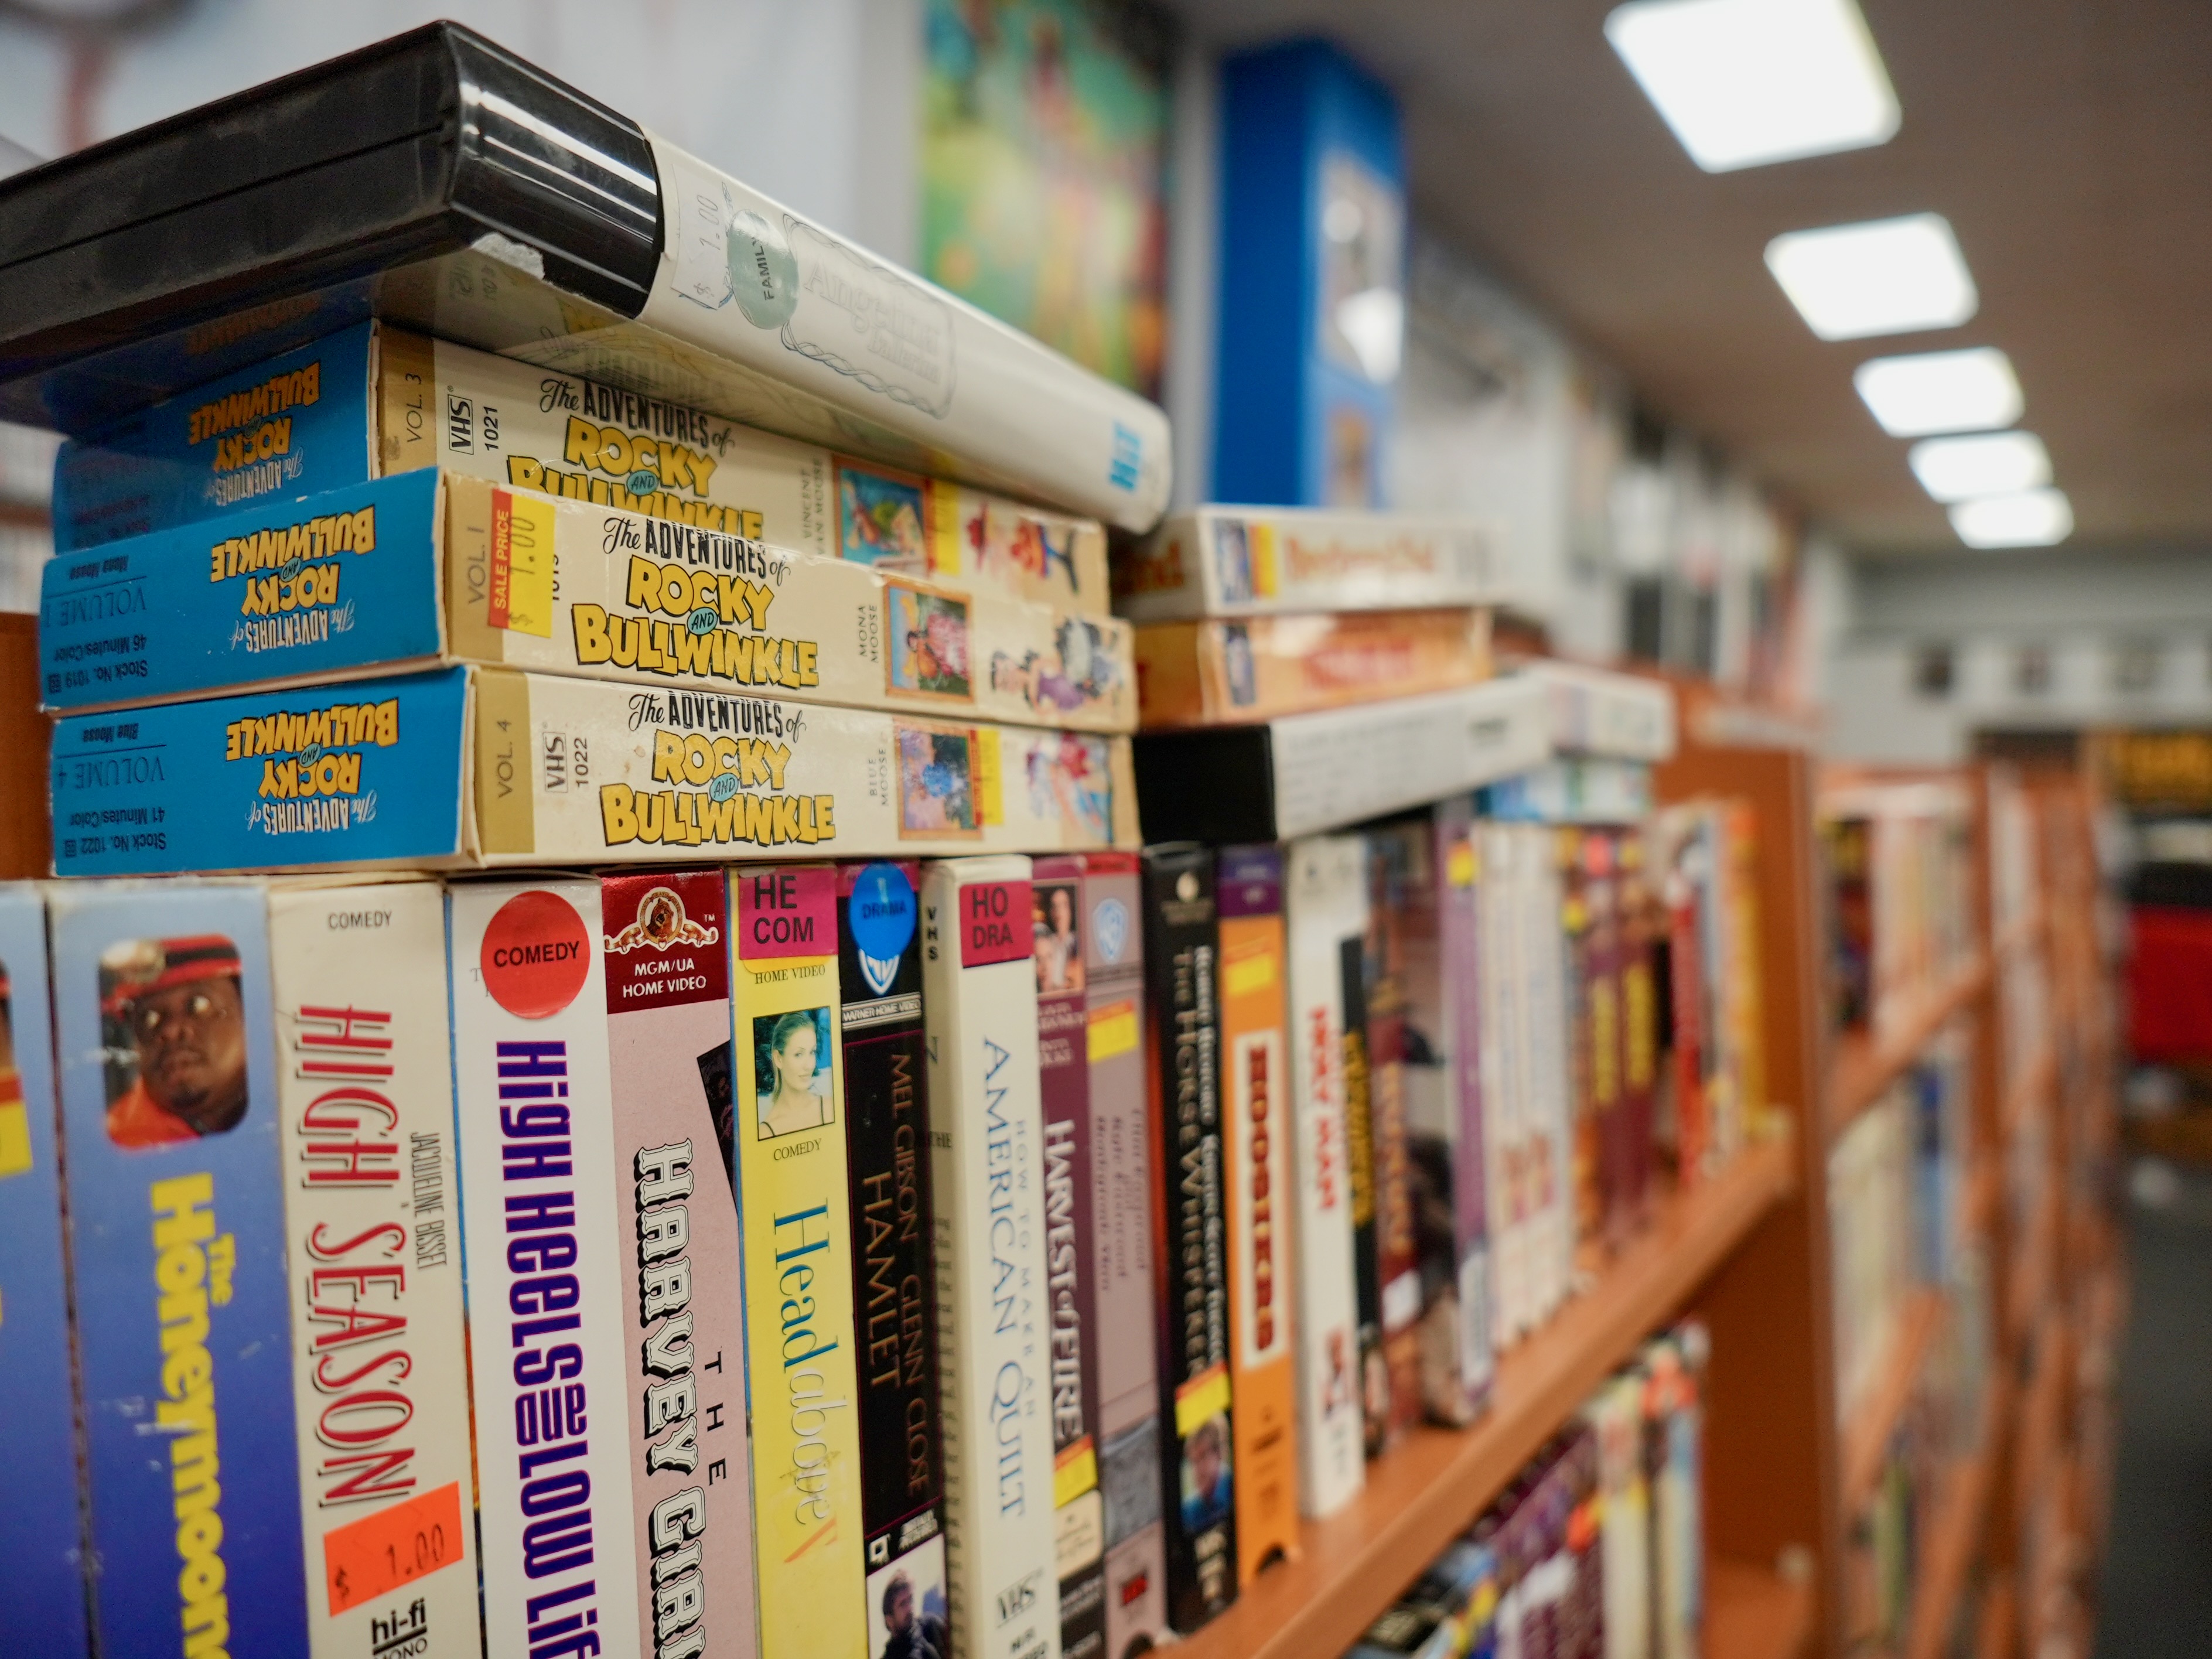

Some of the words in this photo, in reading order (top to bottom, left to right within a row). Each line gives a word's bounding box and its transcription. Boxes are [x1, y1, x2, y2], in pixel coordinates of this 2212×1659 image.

[187, 360, 321, 446] BULLWINKLE
[406, 373, 422, 385] 3
[450, 397, 472, 447] VHS
[483, 407, 499, 451] 1021
[540, 378, 580, 413] The
[583, 381, 709, 449] ADVENTURES
[712, 426, 735, 456] of
[213, 417, 293, 472] ROCKY
[564, 415, 718, 497] ROCKY
[631, 474, 655, 490] AND
[210, 504, 376, 583] BULLWINKLE
[496, 509, 509, 561] PRICE
[603, 517, 641, 555] The
[645, 518, 767, 579] ADVENTURES
[770, 554, 791, 586] of
[241, 563, 340, 617] ROCKY
[282, 559, 300, 580] AND
[494, 564, 508, 609] SALE
[626, 554, 774, 631] ROCKY
[59, 586, 146, 628] VOLUME
[245, 607, 329, 654] ADVENTURES
[332, 599, 356, 634] The
[691, 612, 714, 630] AND
[858, 605, 868, 657] MONA
[571, 603, 820, 689] BULLWINKLE
[869, 604, 879, 663] MOOSE
[114, 658, 149, 679] Stock
[225, 697, 400, 762] BULLWINKLE
[496, 719, 511, 732] 4
[628, 694, 665, 732] The
[668, 691, 783, 738] ADVENTURES
[786, 710, 806, 742] of
[74, 756, 165, 791] VOLUME
[257, 752, 363, 800] ROCKY
[302, 746, 319, 763] AND
[499, 742, 514, 799] VOL.
[545, 736, 566, 789] VHS
[575, 736, 588, 788] 1022
[651, 729, 791, 790] ROCKY
[353, 789, 377, 822] The
[713, 777, 735, 796] AND
[151, 807, 165, 822] 41
[264, 796, 350, 836] ADVENTURES
[600, 782, 836, 847] BULLWINKLE
[80, 838, 107, 856] 1022
[132, 834, 168, 852] Stock
[754, 875, 797, 910] HE
[972, 886, 1009, 919] HO
[327, 911, 392, 930] COMEDY
[753, 917, 814, 944] COM
[973, 923, 1013, 949] DRA
[494, 941, 579, 967] COMEDY
[634, 958, 695, 977] MGM/UA
[755, 971, 788, 984] HOME
[791, 965, 826, 979] VIDEO
[623, 982, 665, 998] HOME
[667, 976, 707, 993] VIDEO
[295, 1004, 400, 1190] HIGH
[891, 1054, 914, 1119] MEL
[411, 1131, 444, 1218] JACQUELINE
[773, 1138, 822, 1161] COMEDY
[894, 1124, 920, 1244] GIBSON
[984, 1036, 1018, 1334] AMERICAN
[1044, 1119, 1078, 1290] HARVEST
[774, 1197, 839, 1374] Head
[863, 1172, 901, 1389] HAMLET
[634, 1138, 699, 1476] HARVEY
[900, 1274, 926, 1386] GLENN
[305, 1221, 417, 1510] SEASON
[1052, 1327, 1083, 1440] FIRE
[151, 1172, 232, 1659] Honeymoon
[705, 1351, 727, 1486] THE
[989, 1360, 1027, 1518] QUILT
[906, 1397, 931, 1498] CLOSE
[371, 1597, 426, 1644] hi-fi
